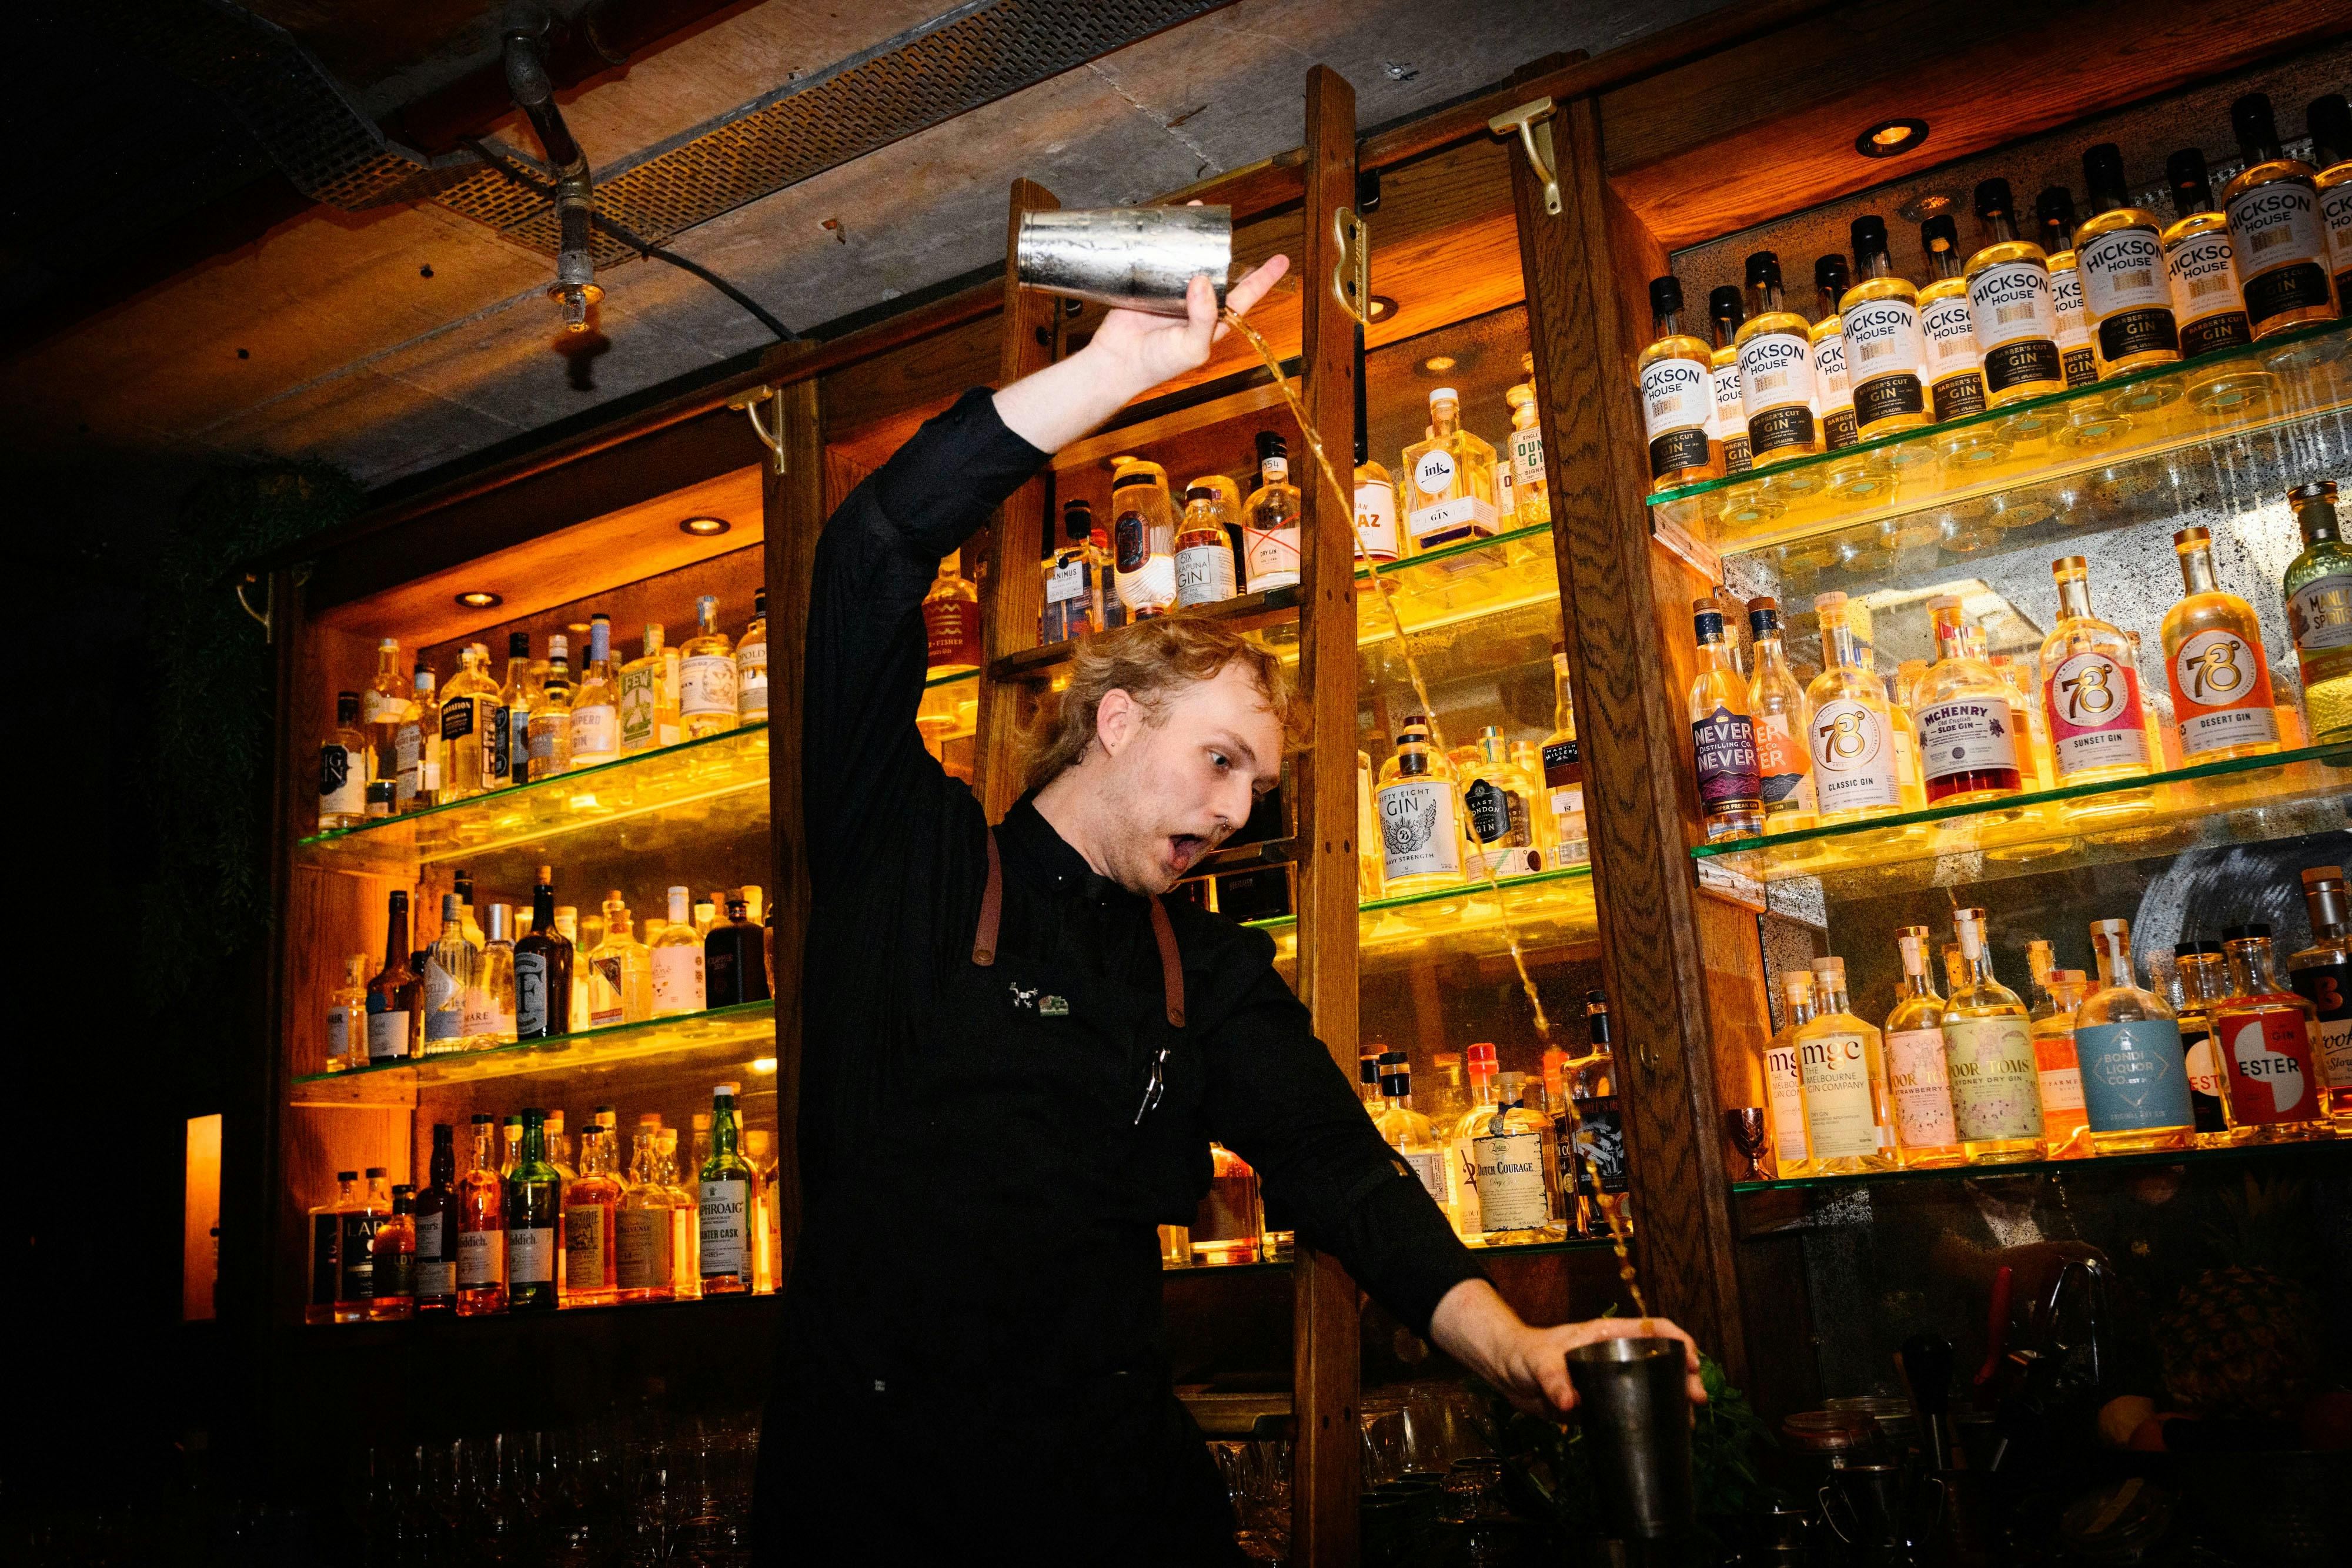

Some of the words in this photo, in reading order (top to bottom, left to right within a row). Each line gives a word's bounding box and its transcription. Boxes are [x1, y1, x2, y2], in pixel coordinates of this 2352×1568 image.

[2229, 195, 2310, 235] HICKSON
[2245, 211, 2292, 233] HOUSE
[2086, 240, 2164, 273] HICKSON
[2107, 257, 2152, 272] HOUSE
[2183, 261, 2229, 280] HOUSE
[1973, 273, 2048, 307] HICKSON
[1992, 290, 2034, 306] HOUSE
[2227, 315, 2244, 323] CUT
[1843, 310, 1912, 343] HICKSON
[2126, 320, 2155, 335] GIN
[2203, 325, 2233, 340] GIN
[1856, 326, 1895, 343] HOUSE
[1740, 344, 1805, 376] HICKSON
[2009, 353, 2037, 366] GIN
[2068, 360, 2095, 373] GIN
[1750, 359, 1788, 375] HOUSE
[1641, 367, 1700, 396] HICKSON
[1859, 381, 1891, 396] BARBER'S
[1938, 378, 1971, 393] BARBER'S
[1648, 383, 1683, 401] HOUSE
[1870, 387, 1897, 402] GIN
[1950, 385, 1976, 399] GIN
[1753, 412, 1784, 426] BARBER'S
[1763, 418, 1789, 432] GIN
[1522, 432, 1539, 440] SINGLE
[1728, 447, 1750, 460] GIN
[1425, 462, 1445, 477] ink
[1431, 510, 1449, 521] GIN
[1260, 549, 1268, 557] DRY
[1053, 569, 1077, 581] ANIMUS
[1178, 569, 1202, 588] GIN
[2309, 589, 2350, 614] MANLY
[625, 670, 649, 692] FEW
[1937, 718, 1947, 727] Old
[1949, 716, 1972, 725] English
[2200, 714, 2233, 728] DESERT
[2236, 713, 2251, 721] GIN
[1695, 723, 1753, 746] NEVER
[1938, 724, 1957, 734] SLOE
[1699, 741, 1739, 754] DISTILLING
[2073, 735, 2106, 748] SUNSET
[2108, 734, 2122, 742] GIN
[1545, 748, 1578, 761] MILLER'S
[1546, 744, 1576, 753] MARTIN
[1698, 748, 1757, 773] NEVER
[1828, 778, 1857, 791] CLASSIC
[1379, 793, 1396, 804] FIFTY
[1401, 788, 1429, 797] EIGHT
[1387, 797, 1419, 817] GIN
[1471, 799, 1492, 808] EAST
[1476, 823, 1495, 834] GIN
[1386, 858, 1397, 867] NAVY
[1399, 853, 1434, 862] STRENGTH
[2271, 1031, 2294, 1042] GIN
[1802, 1040, 1860, 1071] mgc
[2104, 1051, 2145, 1063] BONDI
[1805, 1066, 1819, 1075] THE
[1986, 1059, 2029, 1074] TOMS
[2106, 1061, 2154, 1075] LIQUOR
[2239, 1058, 2300, 1076] ESTER
[1806, 1072, 1857, 1084] MELBOURNE
[1955, 1077, 1983, 1086] SYDNEY
[1774, 1090, 1785, 1098] GIN
[1808, 1084, 1820, 1093] GIN
[1822, 1081, 1864, 1092] COMPANY
[1895, 1086, 1943, 1095] STRAWBERRY
[1477, 1164, 1495, 1176] DUTCH
[1497, 1161, 1533, 1175] COURAGE
[1489, 1178, 1502, 1188] Dry
[720, 1228, 739, 1238] CASK
